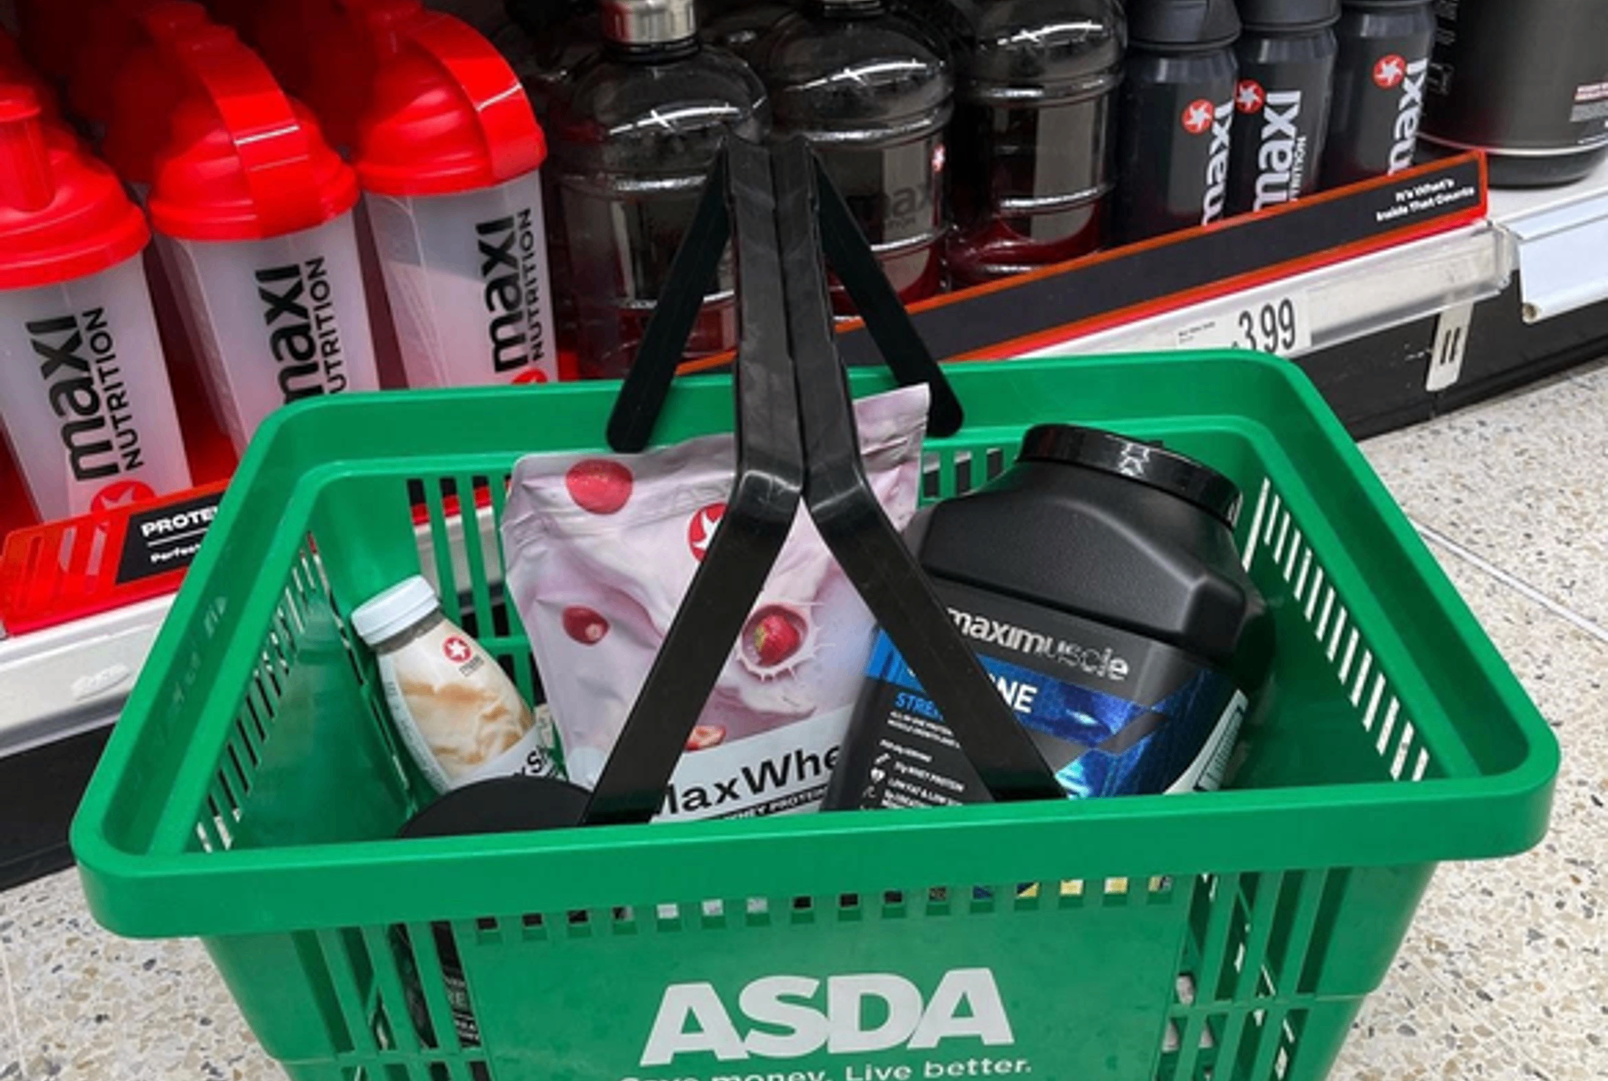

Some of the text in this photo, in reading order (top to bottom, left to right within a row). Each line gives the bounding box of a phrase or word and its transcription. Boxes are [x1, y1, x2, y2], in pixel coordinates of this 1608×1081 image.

[304, 256, 347, 394] UTRITION
[517, 207, 545, 362] NUTRITION
[82, 307, 145, 472] NUTRITION
[661, 744, 841, 815] axWhe
[638, 966, 1015, 1067] ASDA
[845, 1063, 913, 1081] Live
[923, 1057, 1032, 1078] better.
